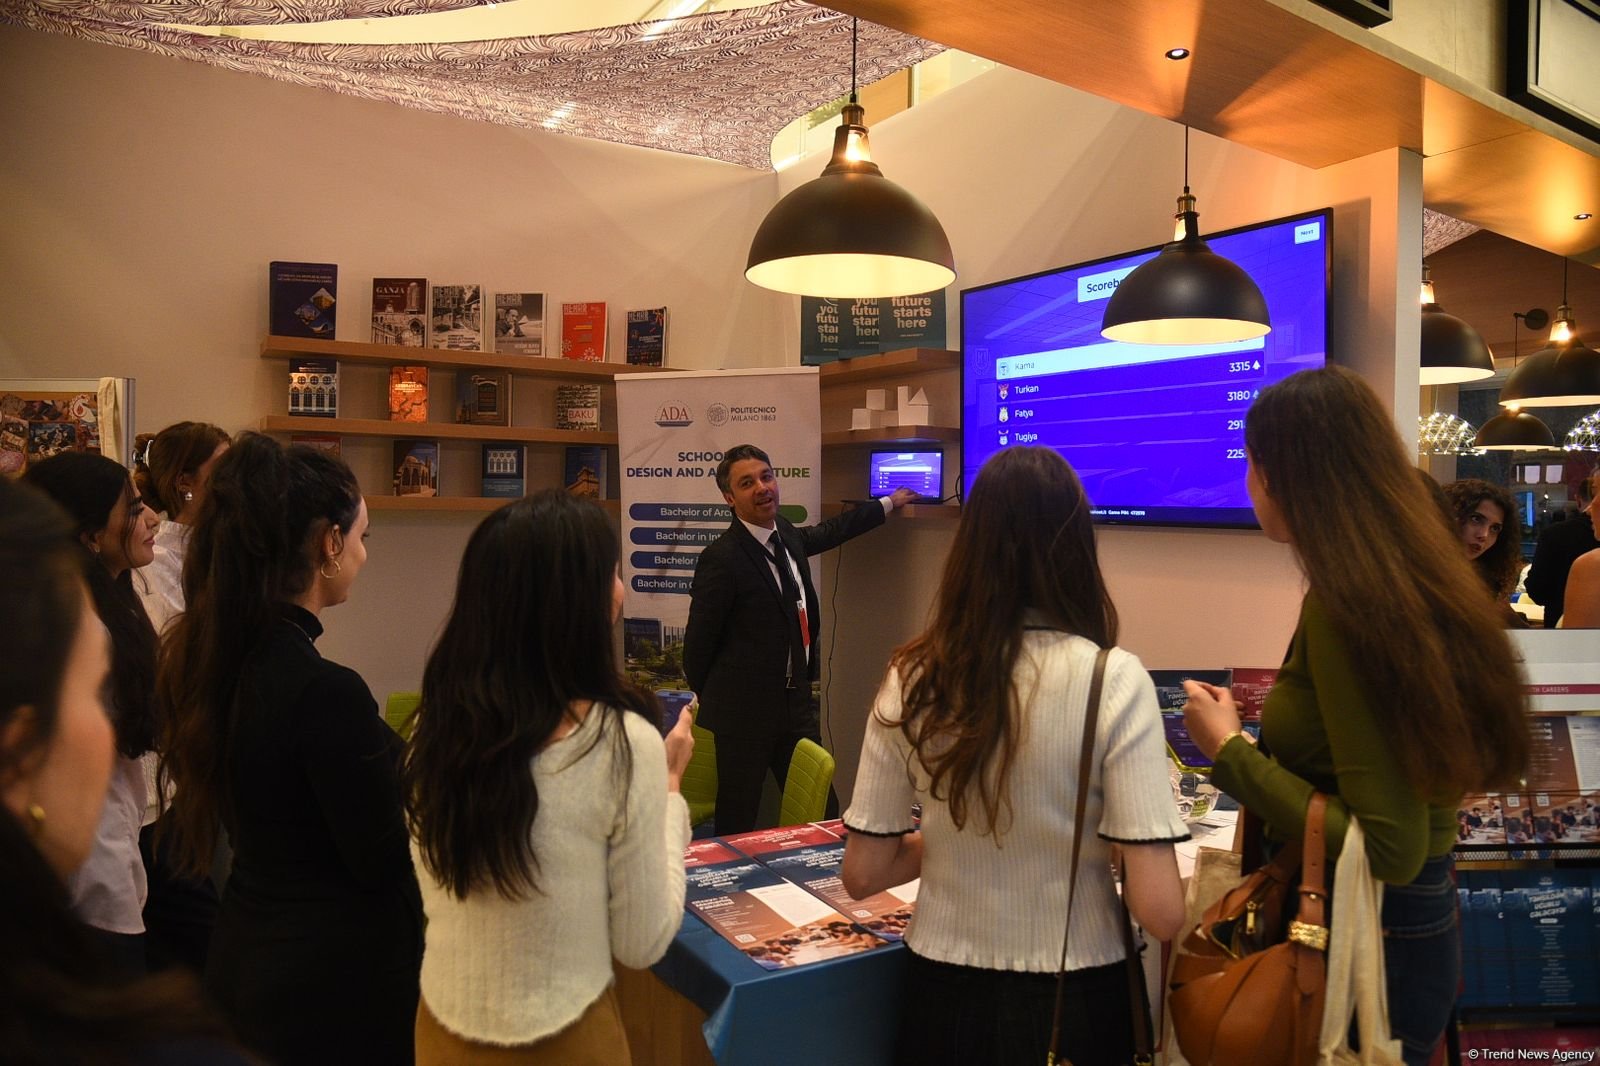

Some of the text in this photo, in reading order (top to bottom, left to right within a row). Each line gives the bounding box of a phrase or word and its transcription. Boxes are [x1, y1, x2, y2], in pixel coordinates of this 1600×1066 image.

[375, 286, 405, 294] GANJA
[891, 296, 931, 307] future
[893, 307, 932, 318] starts
[897, 318, 927, 329] here
[1229, 361, 1251, 372] 3315
[1014, 385, 1250, 401] Turkan 3180
[568, 410, 594, 418] BAKU
[660, 406, 689, 420] ADA
[1015, 432, 1038, 443] Tugiya
[626, 467, 673, 478] DESIGN
[676, 467, 703, 478] AND
[660, 507, 700, 516] Bachelor
[702, 508, 712, 516] of
[655, 531, 696, 540] Bachelor
[697, 532, 707, 540] in
[654, 555, 694, 565] Bachelor
[637, 579, 677, 588] Bachelor
[678, 580, 687, 588] in
